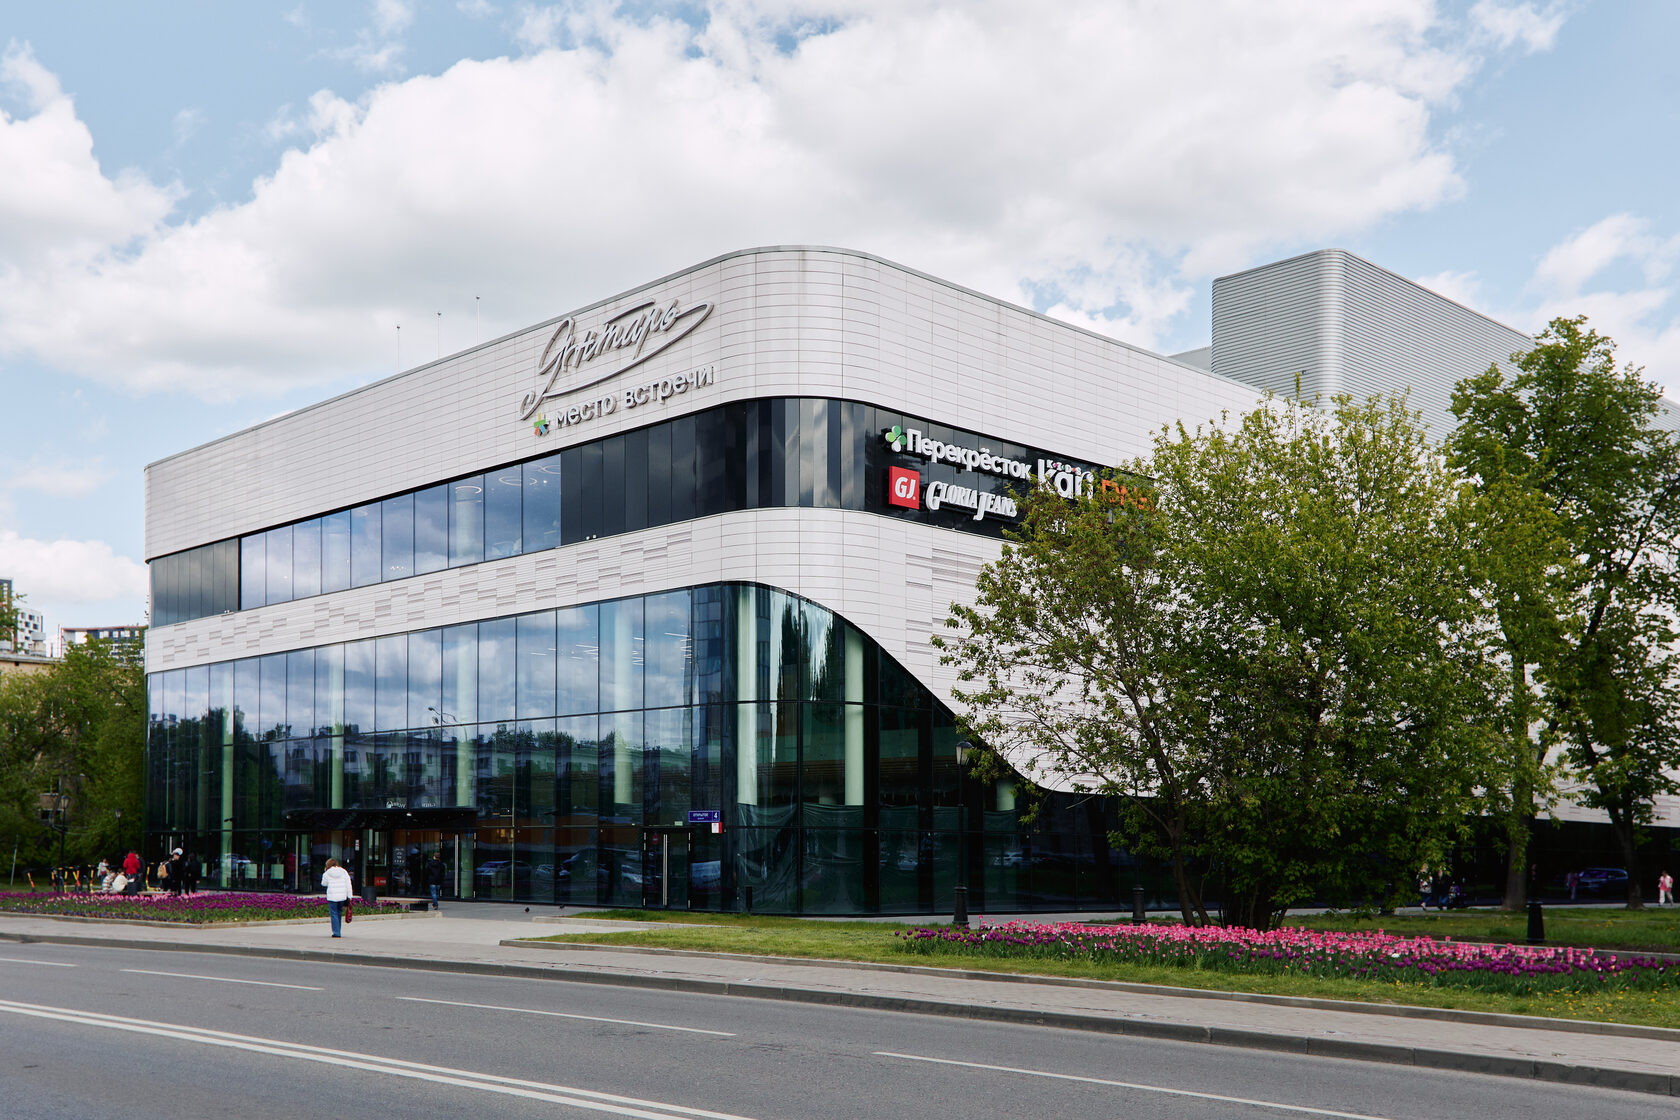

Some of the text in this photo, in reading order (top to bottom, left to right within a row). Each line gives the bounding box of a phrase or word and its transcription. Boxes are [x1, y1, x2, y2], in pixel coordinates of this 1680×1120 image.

[556, 365, 714, 429] место встречи
[906, 428, 1032, 480] Перекрёсток
[894, 476, 916, 500] GJ
